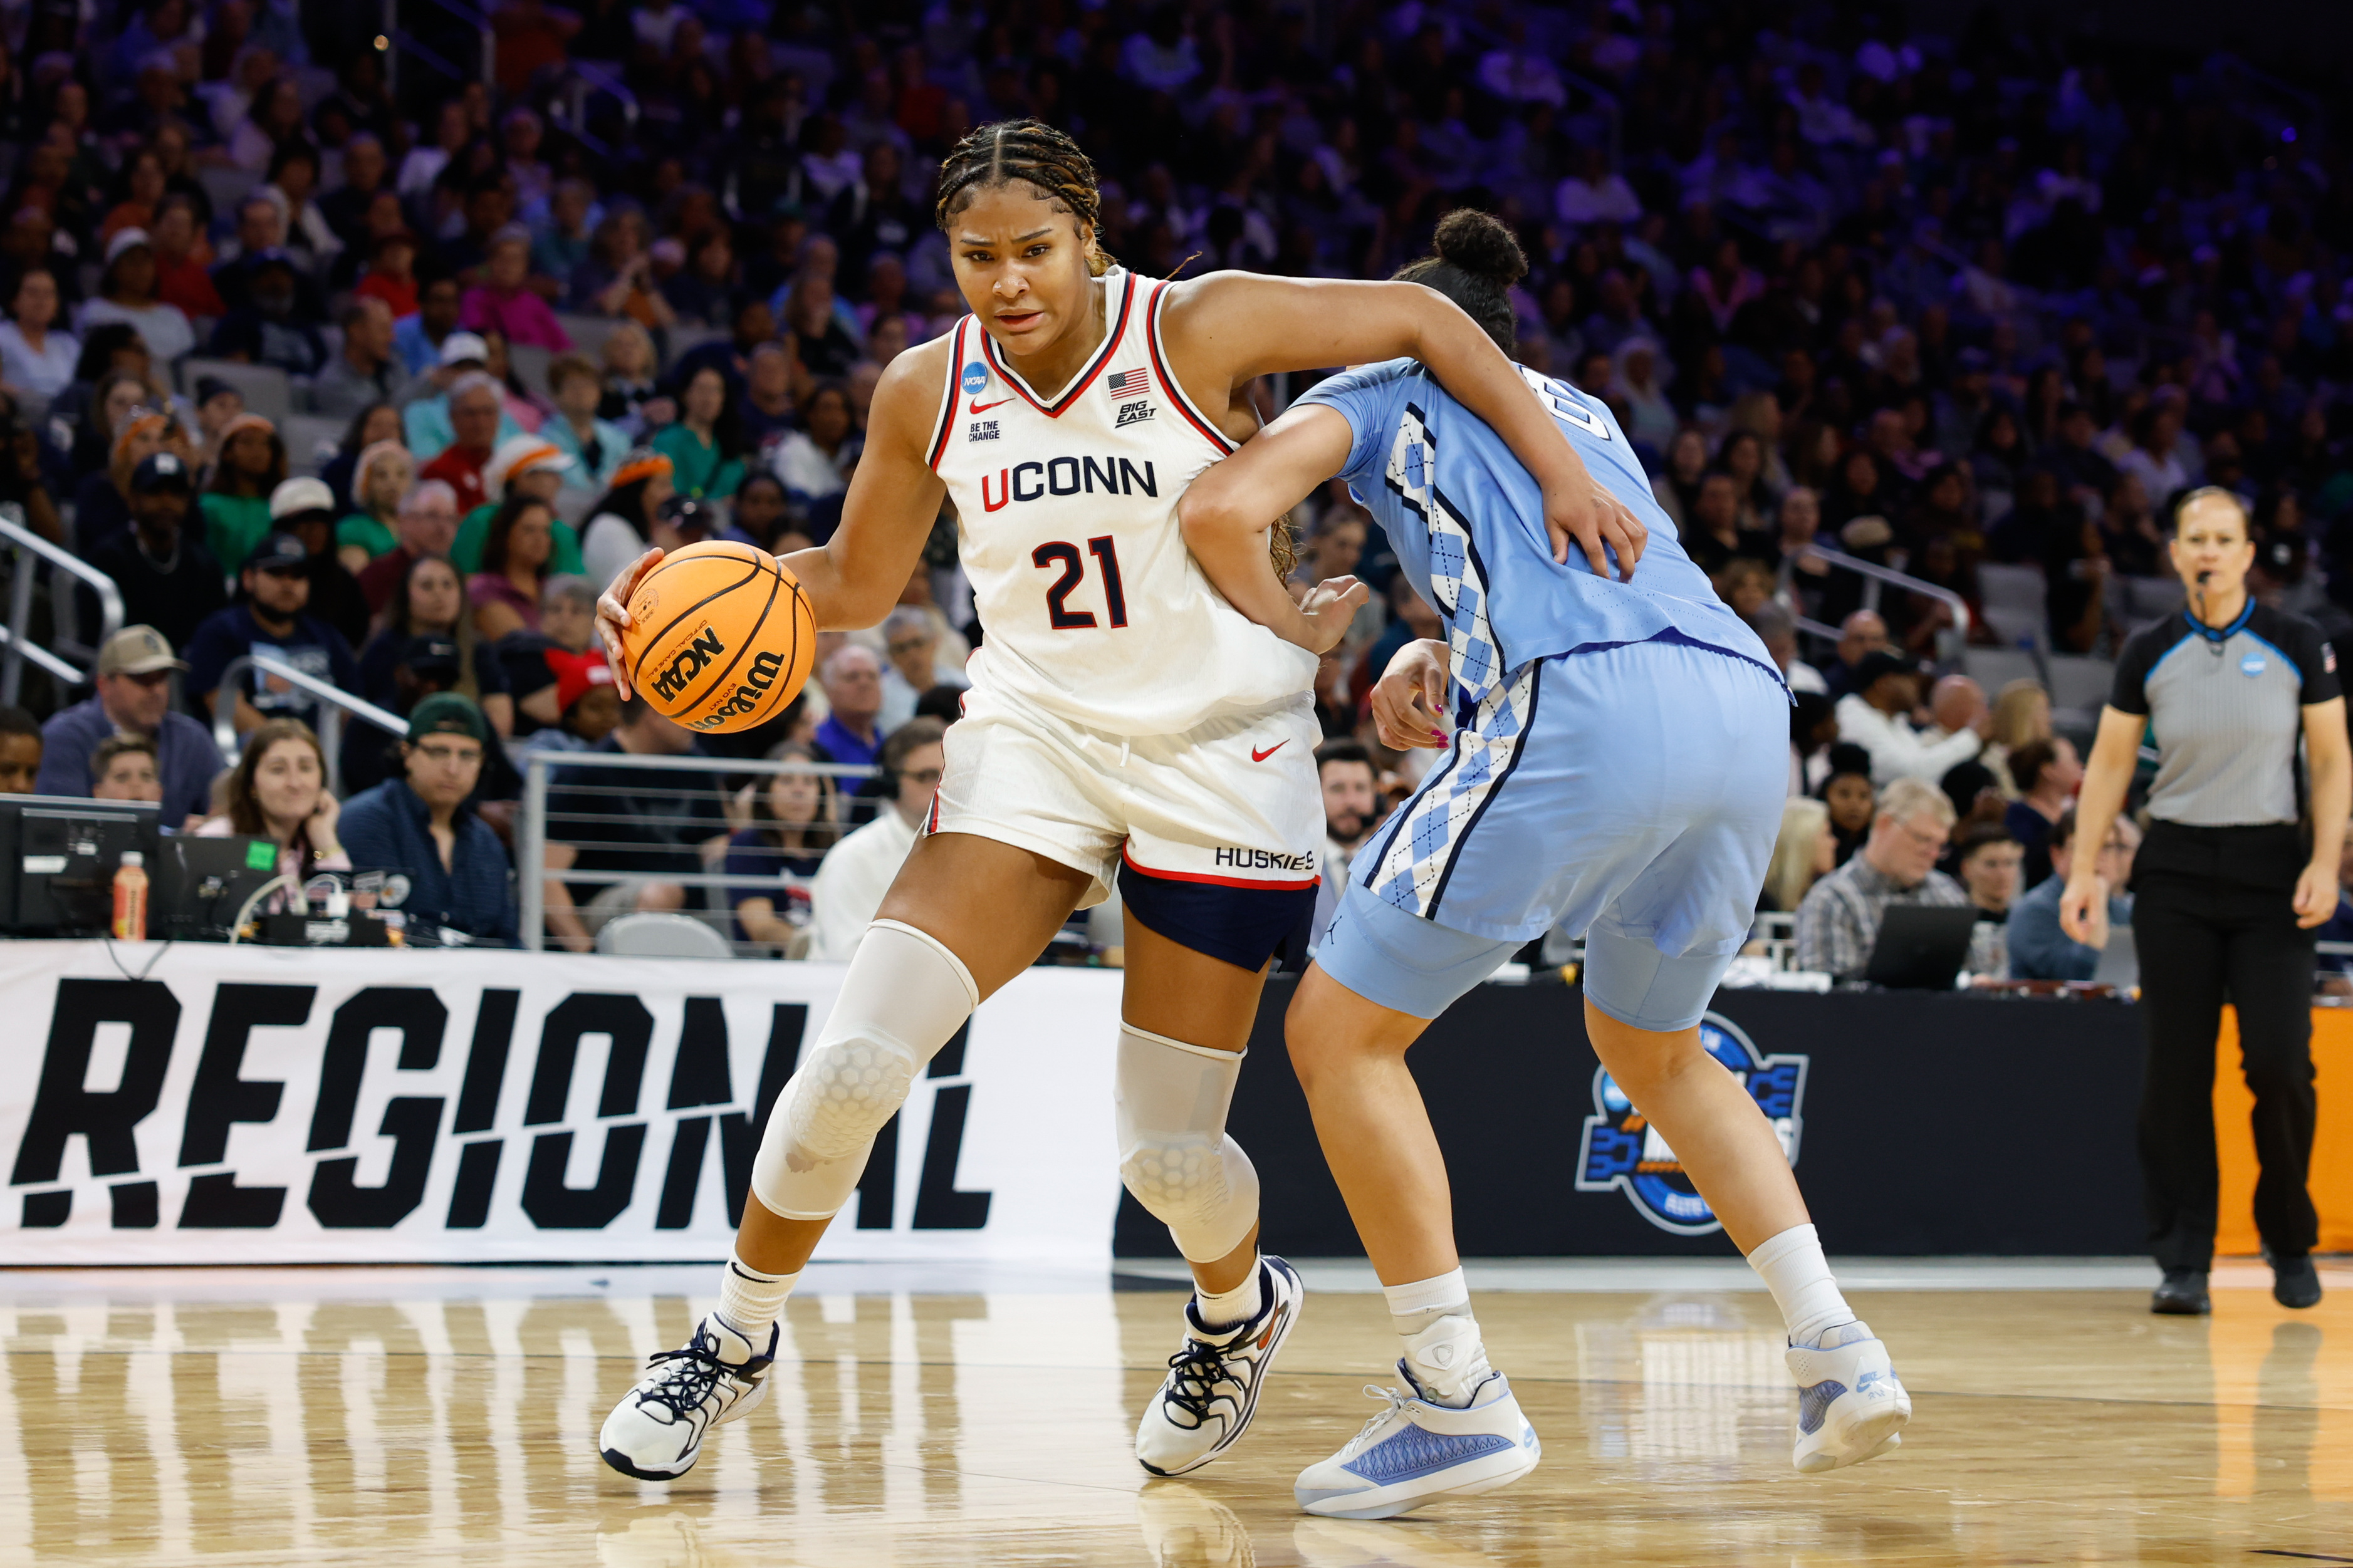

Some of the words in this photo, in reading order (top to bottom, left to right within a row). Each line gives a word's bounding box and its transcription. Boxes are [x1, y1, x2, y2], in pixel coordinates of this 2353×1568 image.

[964, 375, 986, 387] NCAA
[1116, 407, 1157, 423] EAST
[1119, 400, 1148, 414] BIG
[970, 422, 981, 433] BE
[983, 420, 999, 430] THE
[968, 430, 1000, 442] CHANGE
[981, 455, 1158, 513] UCONN
[1031, 534, 1128, 630] 21
[676, 619, 707, 648] OFFICIAL
[650, 625, 726, 704] NCAA
[657, 649, 677, 668] GAME
[645, 667, 659, 680] BALL
[684, 650, 785, 731] Wilson
[722, 682, 737, 699] EVO
[709, 698, 724, 712] NXT
[1216, 846, 1315, 871] HUSKIES
